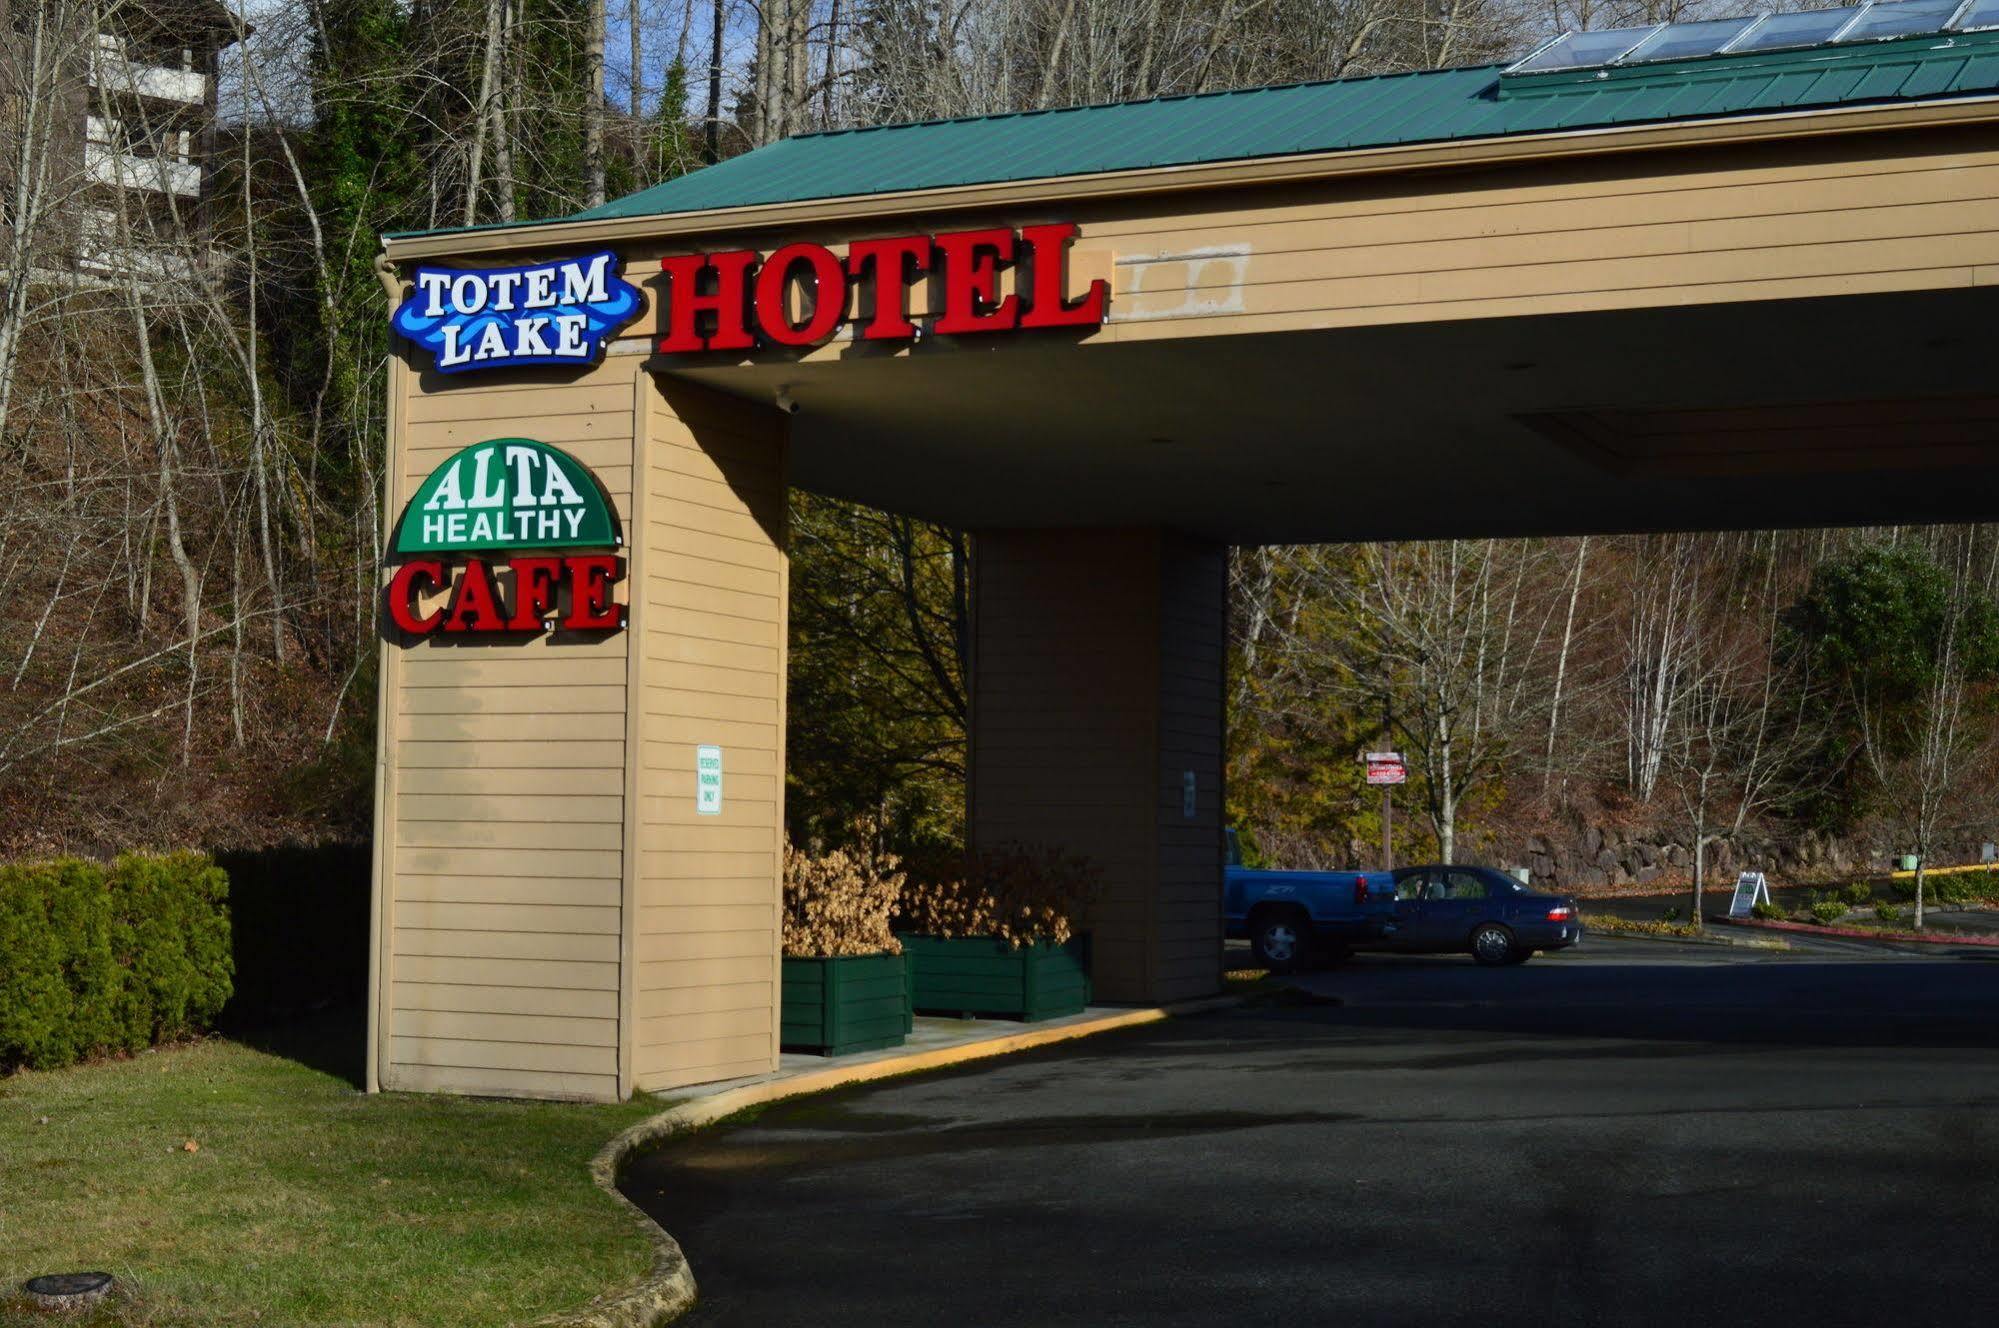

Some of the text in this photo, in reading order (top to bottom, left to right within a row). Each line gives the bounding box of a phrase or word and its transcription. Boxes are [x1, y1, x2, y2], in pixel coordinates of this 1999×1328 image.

[419, 254, 610, 317] TOTEM
[661, 223, 1106, 354] HOTEL
[440, 314, 589, 367] LAKE
[423, 445, 584, 511] ALTA
[423, 508, 587, 544] HEALTHY
[389, 555, 622, 634] CAFE
